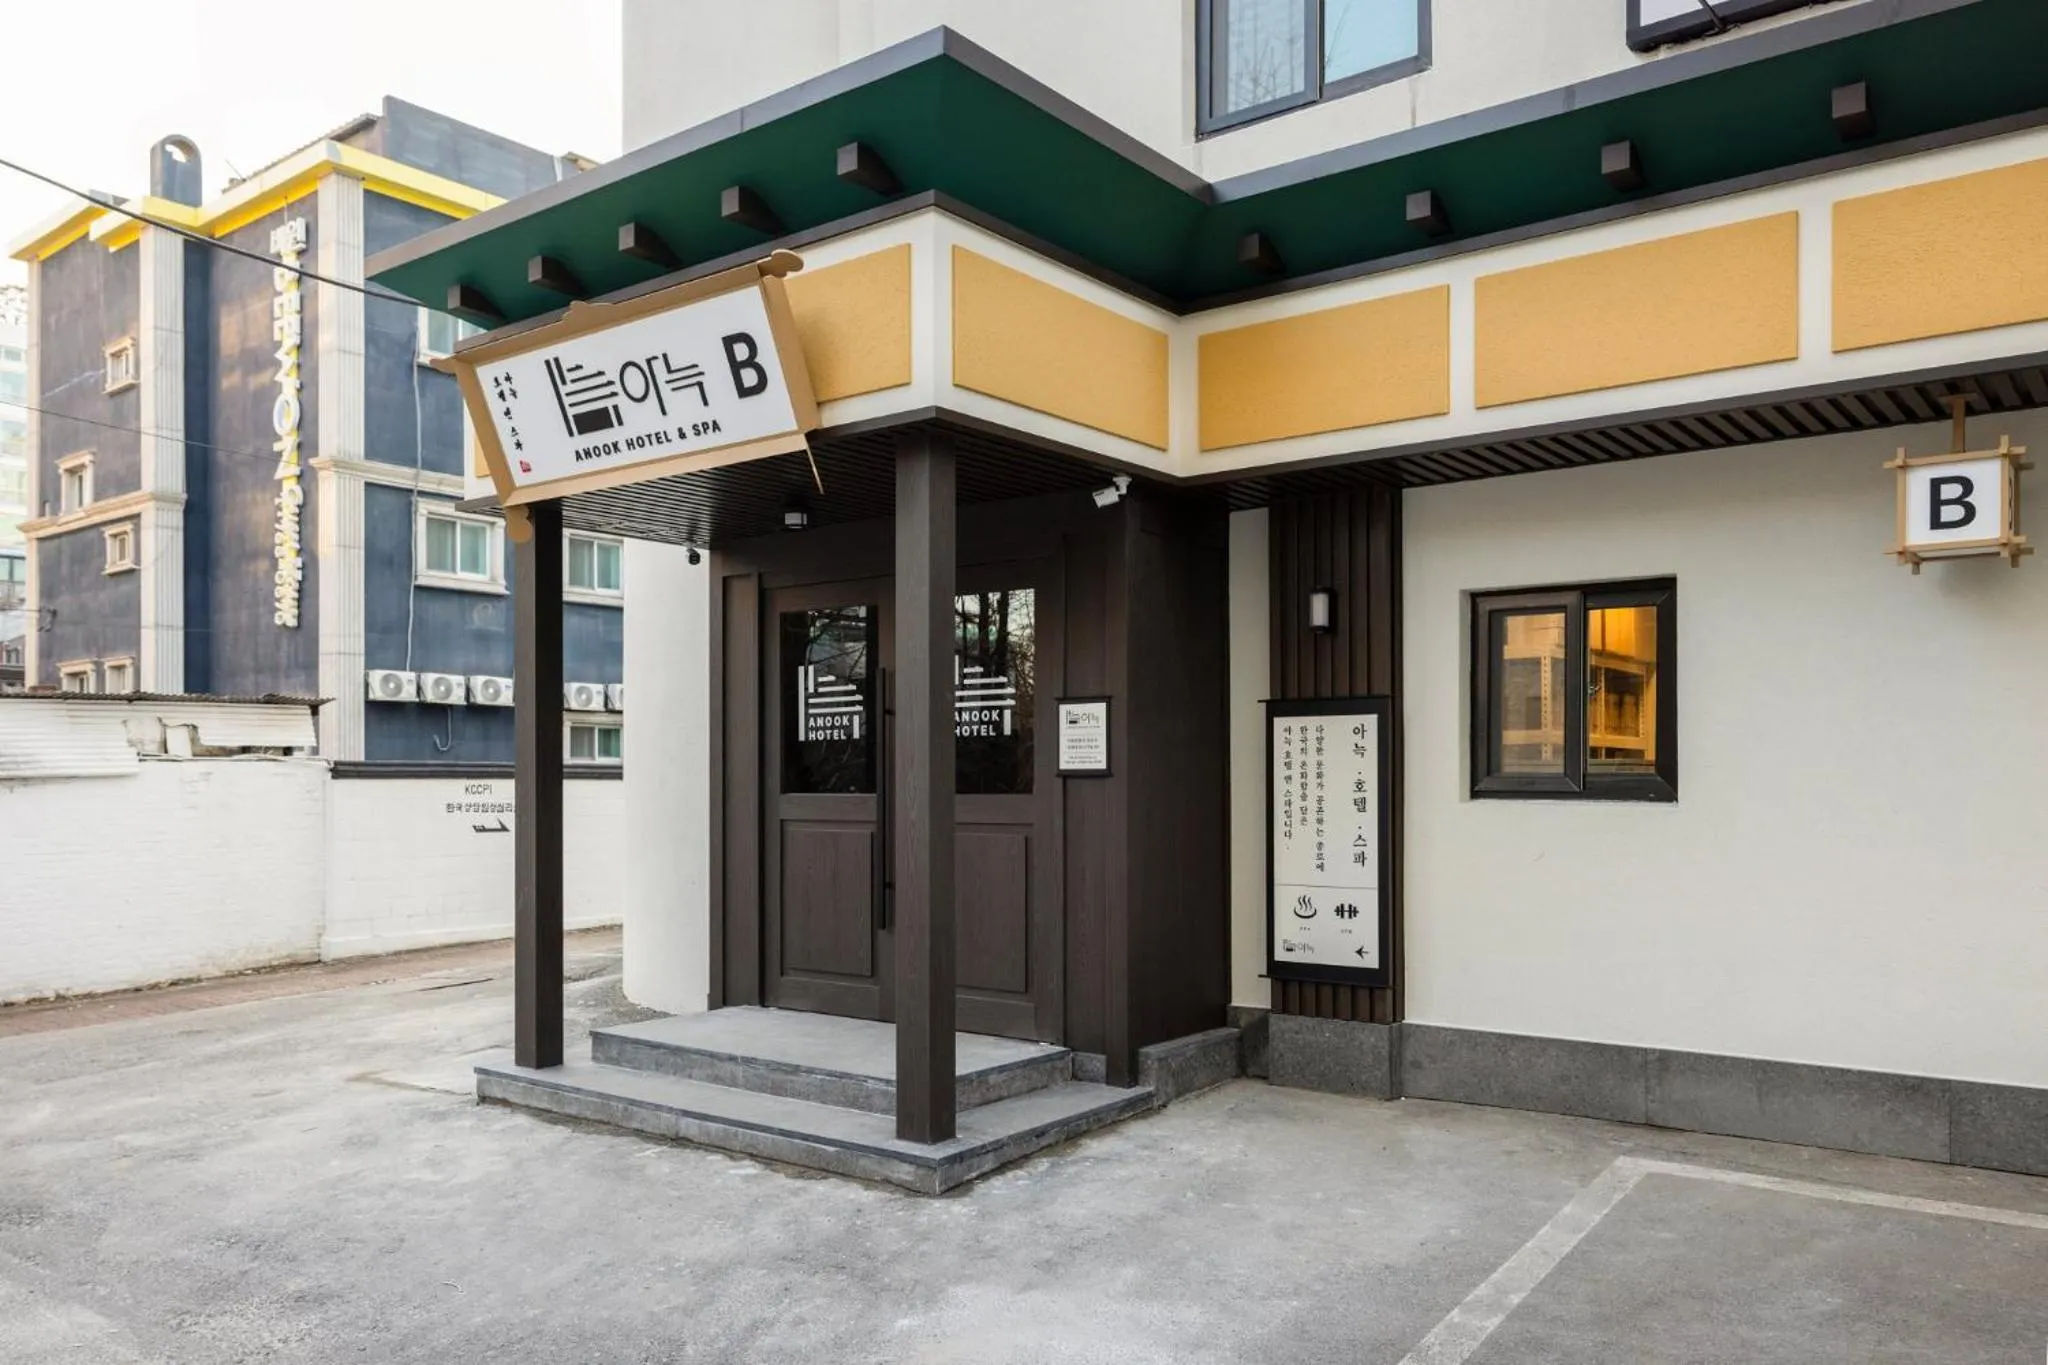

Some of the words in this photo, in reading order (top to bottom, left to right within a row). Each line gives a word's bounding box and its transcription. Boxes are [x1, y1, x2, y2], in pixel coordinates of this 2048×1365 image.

[721, 331, 769, 400] B
[574, 441, 622, 463] ANOOK
[626, 429, 673, 452] HOTEL
[677, 426, 688, 441] &
[691, 419, 723, 438] SPA
[1929, 475, 1977, 531] B
[808, 714, 850, 729] ANOOK
[808, 728, 847, 742] HOTEL
[1352, 723, 1367, 759] 아늑
[1352, 777, 1367, 814] 호텔
[1352, 834, 1368, 869] 스파
